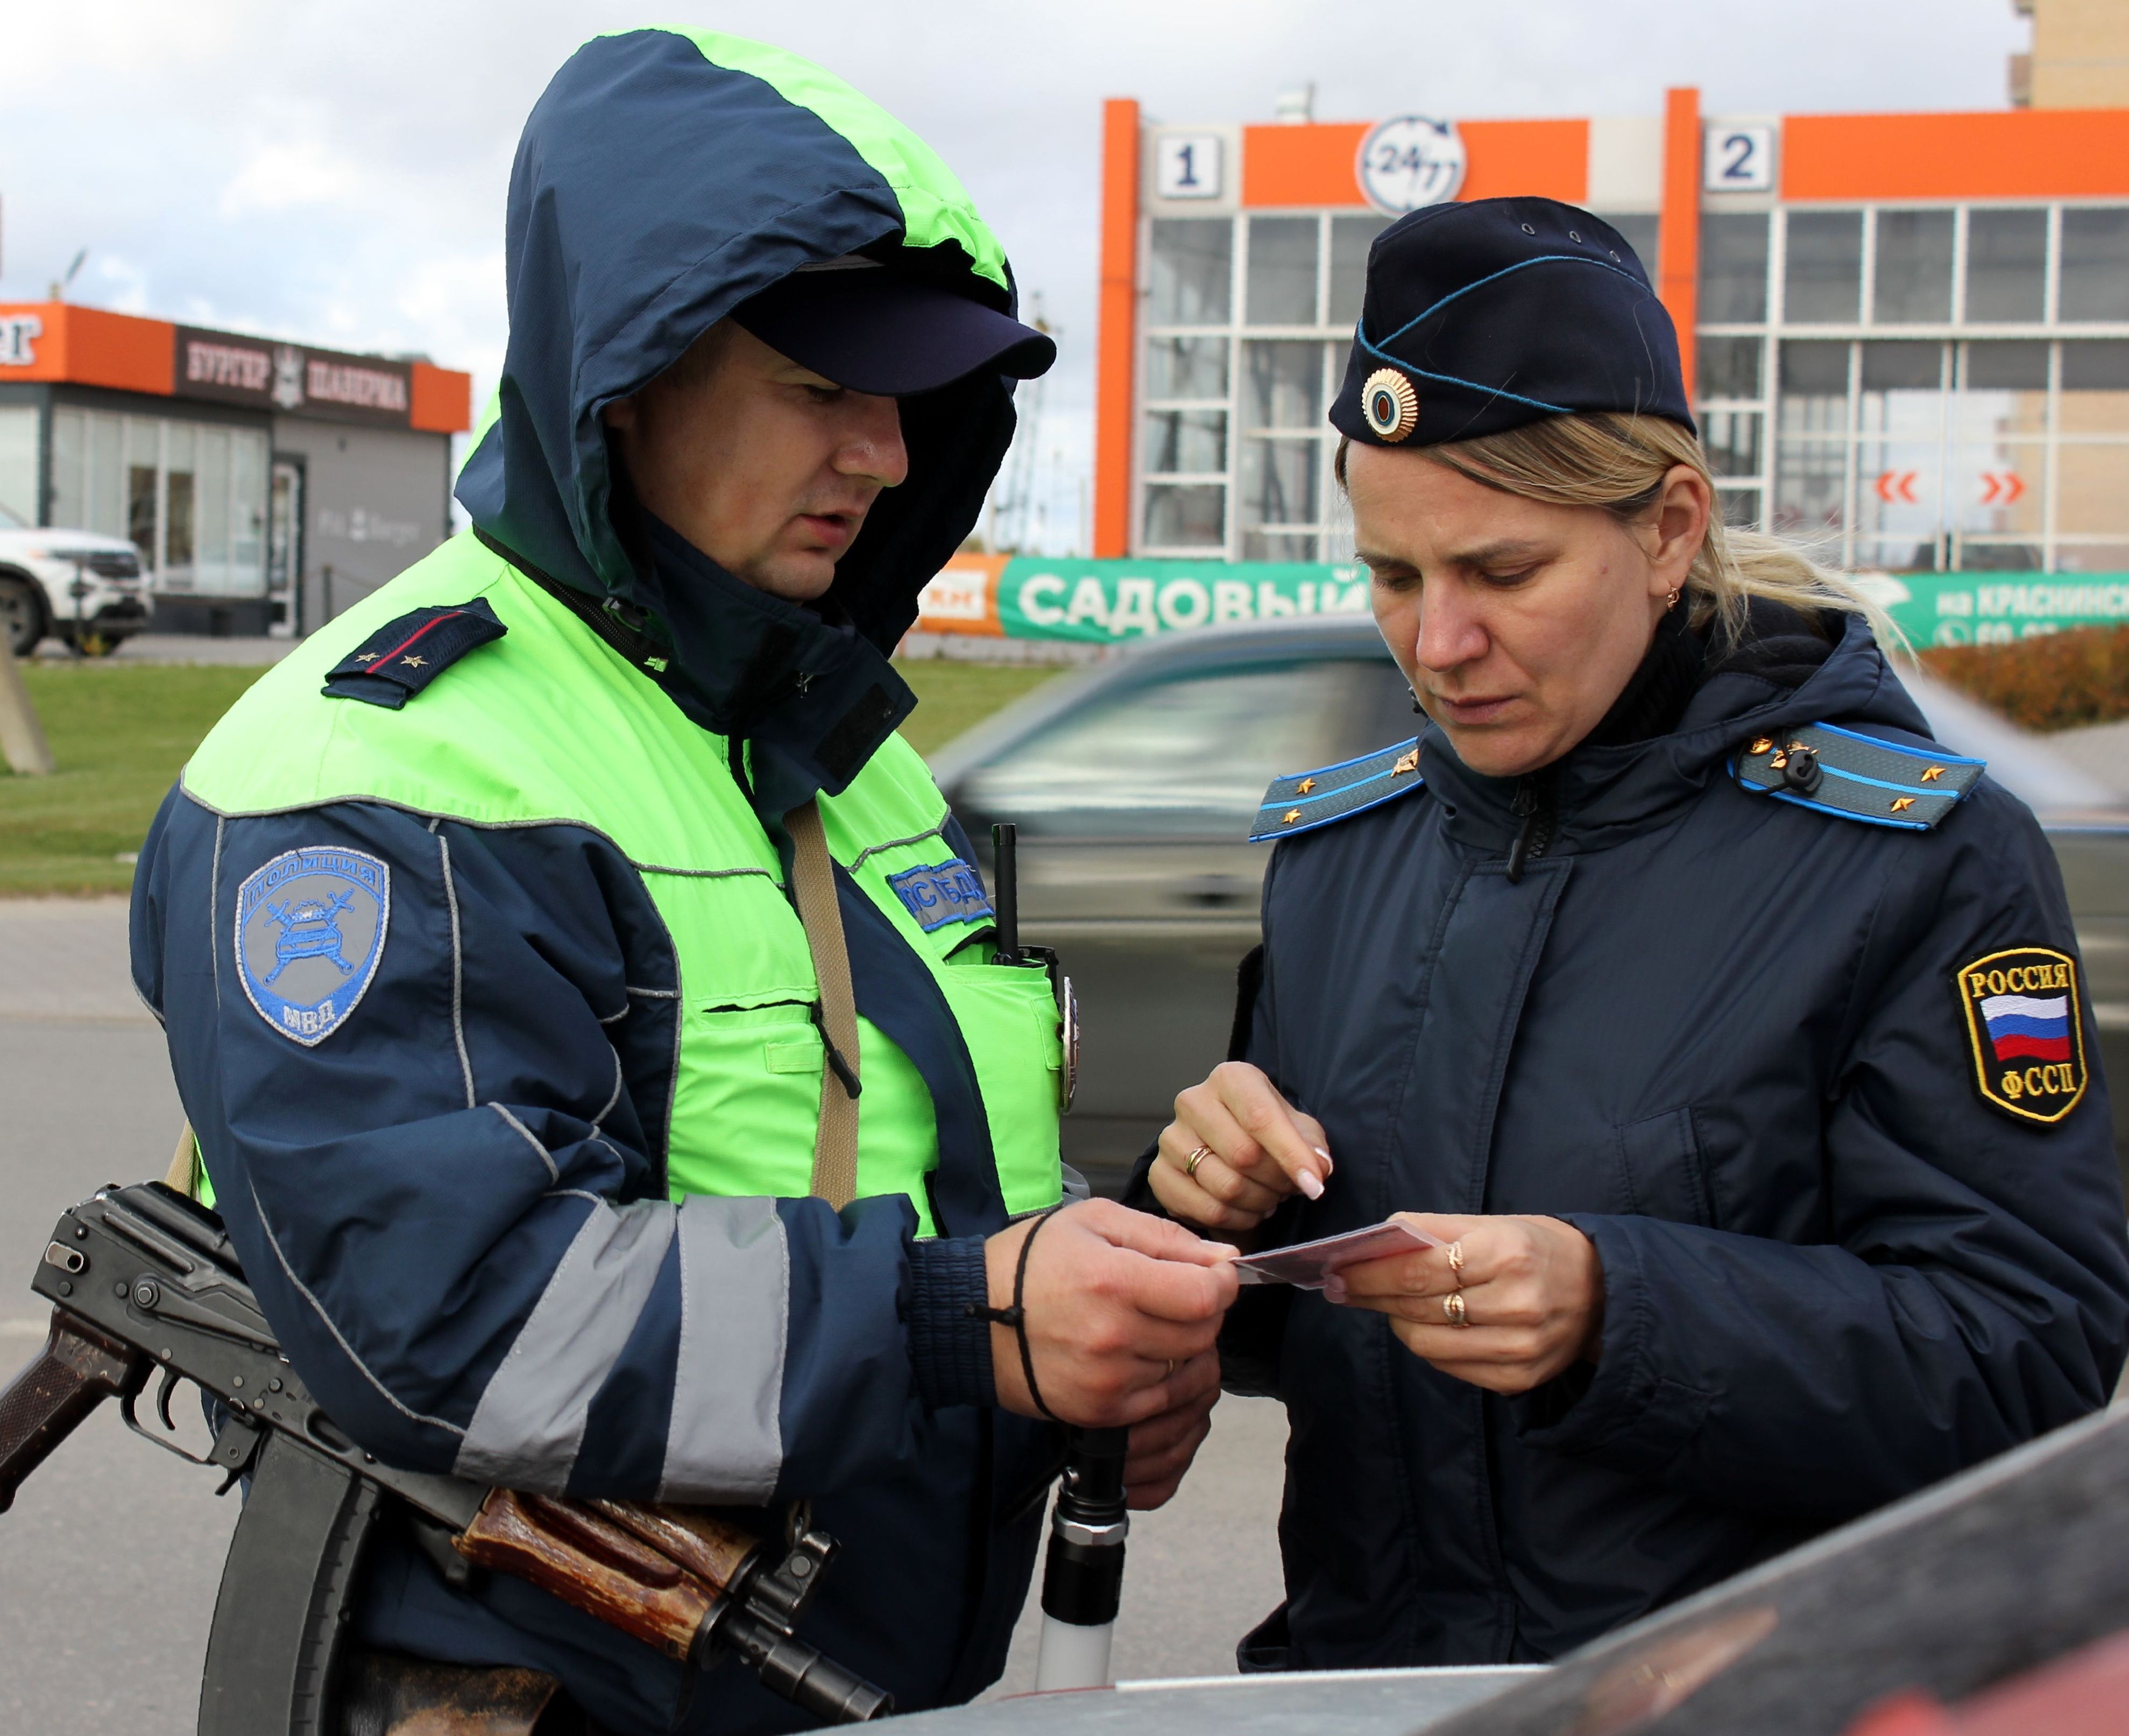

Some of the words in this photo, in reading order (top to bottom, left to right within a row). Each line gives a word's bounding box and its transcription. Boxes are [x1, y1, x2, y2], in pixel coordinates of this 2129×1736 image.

[1175, 142, 1199, 187] 1
[1723, 133, 1755, 178] 2
[188, 342, 270, 389] БУРГЕР
[1018, 568, 1370, 634] САДОВЫЙ
[250, 857, 376, 905] ПОЛИЦИЯ
[1969, 964, 2069, 997] РОССИЯ
[283, 1000, 335, 1035] МВД
[2001, 1063, 2077, 1099] ФССП
